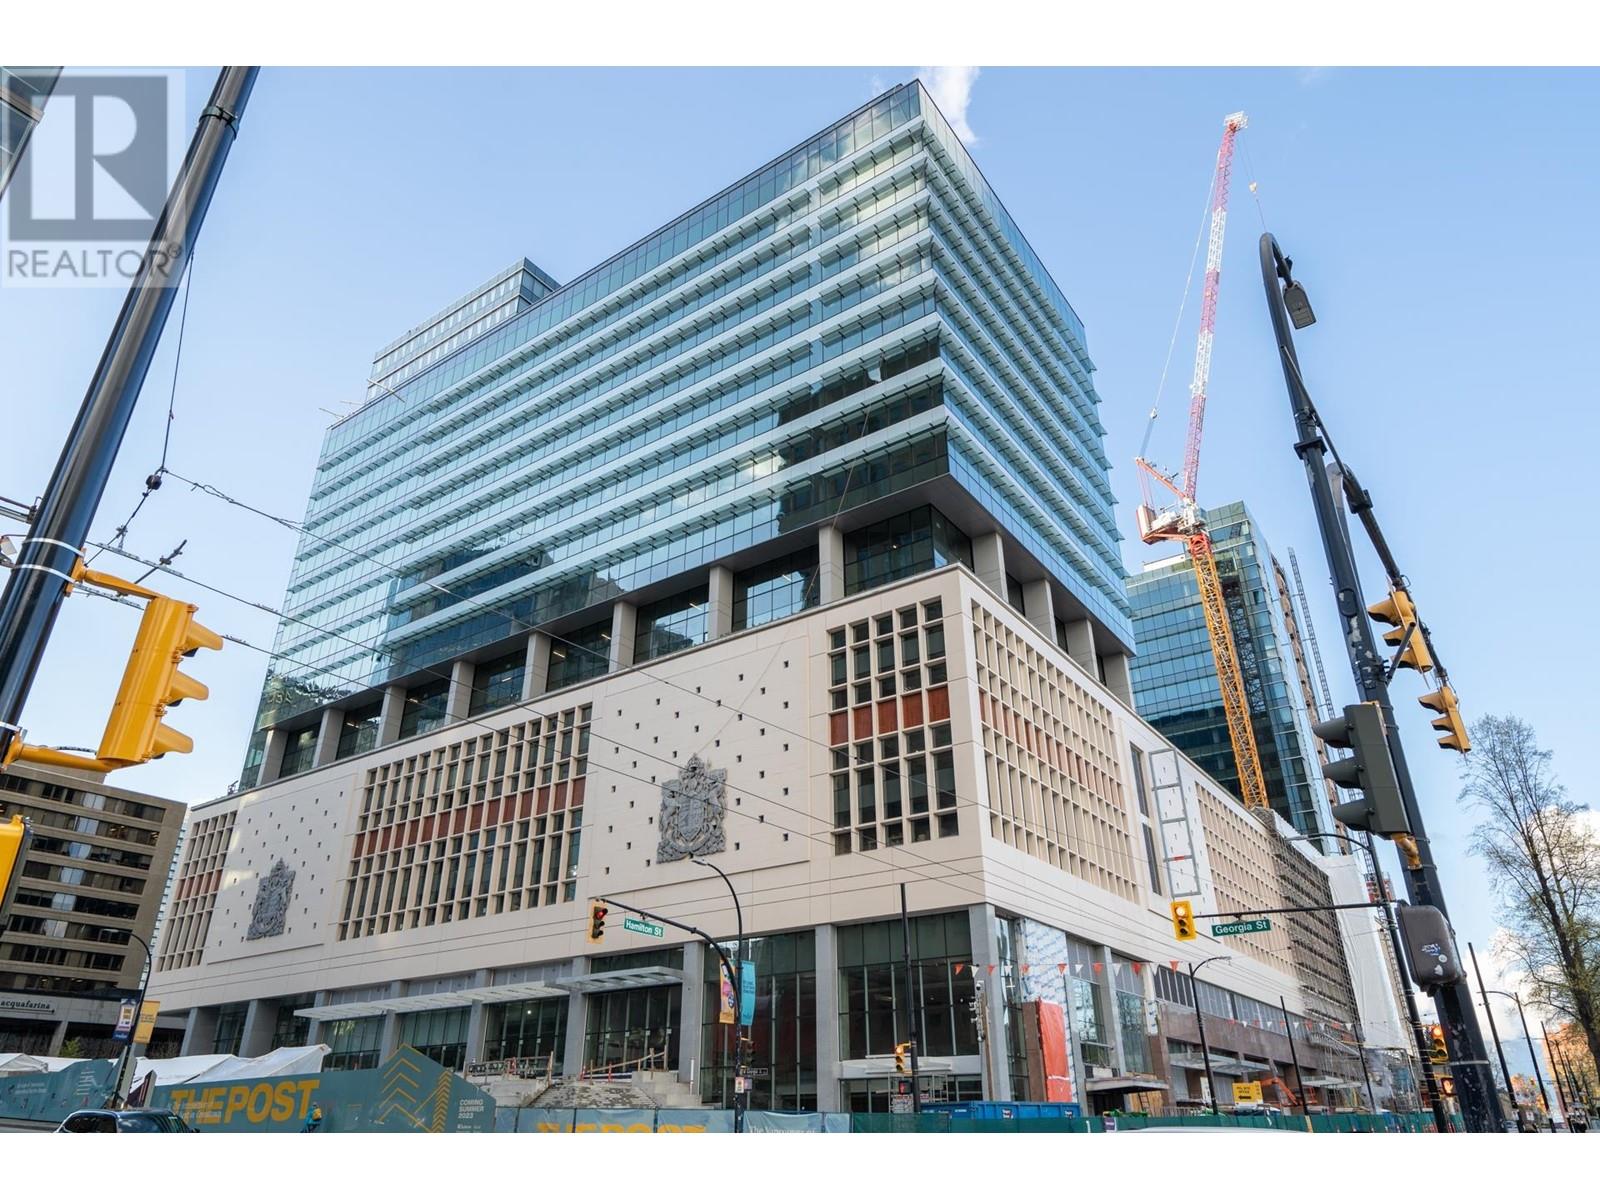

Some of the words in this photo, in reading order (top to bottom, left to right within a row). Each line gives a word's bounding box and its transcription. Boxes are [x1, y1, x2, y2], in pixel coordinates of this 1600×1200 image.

[625, 919, 653, 934] Hamilton
[653, 926, 663, 937] St
[1215, 922, 1252, 934] Georgia
[1256, 920, 1268, 930] St
[0, 1000, 51, 1009] acquafarina
